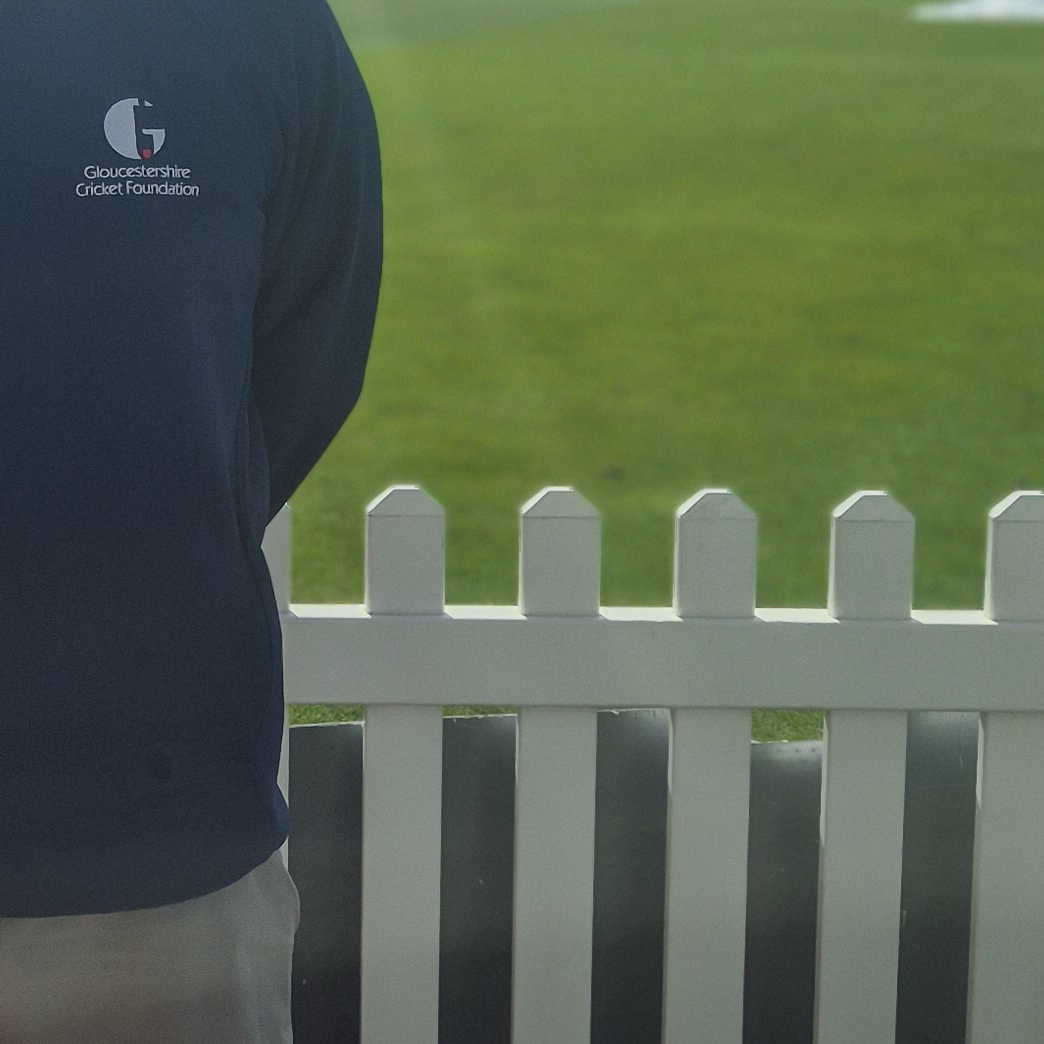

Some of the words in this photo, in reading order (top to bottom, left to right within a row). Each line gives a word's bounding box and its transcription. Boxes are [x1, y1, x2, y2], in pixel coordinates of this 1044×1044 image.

[83, 164, 191, 180] Gloucestershire
[75, 182, 124, 197] Cricket
[125, 180, 200, 197] Foundation
